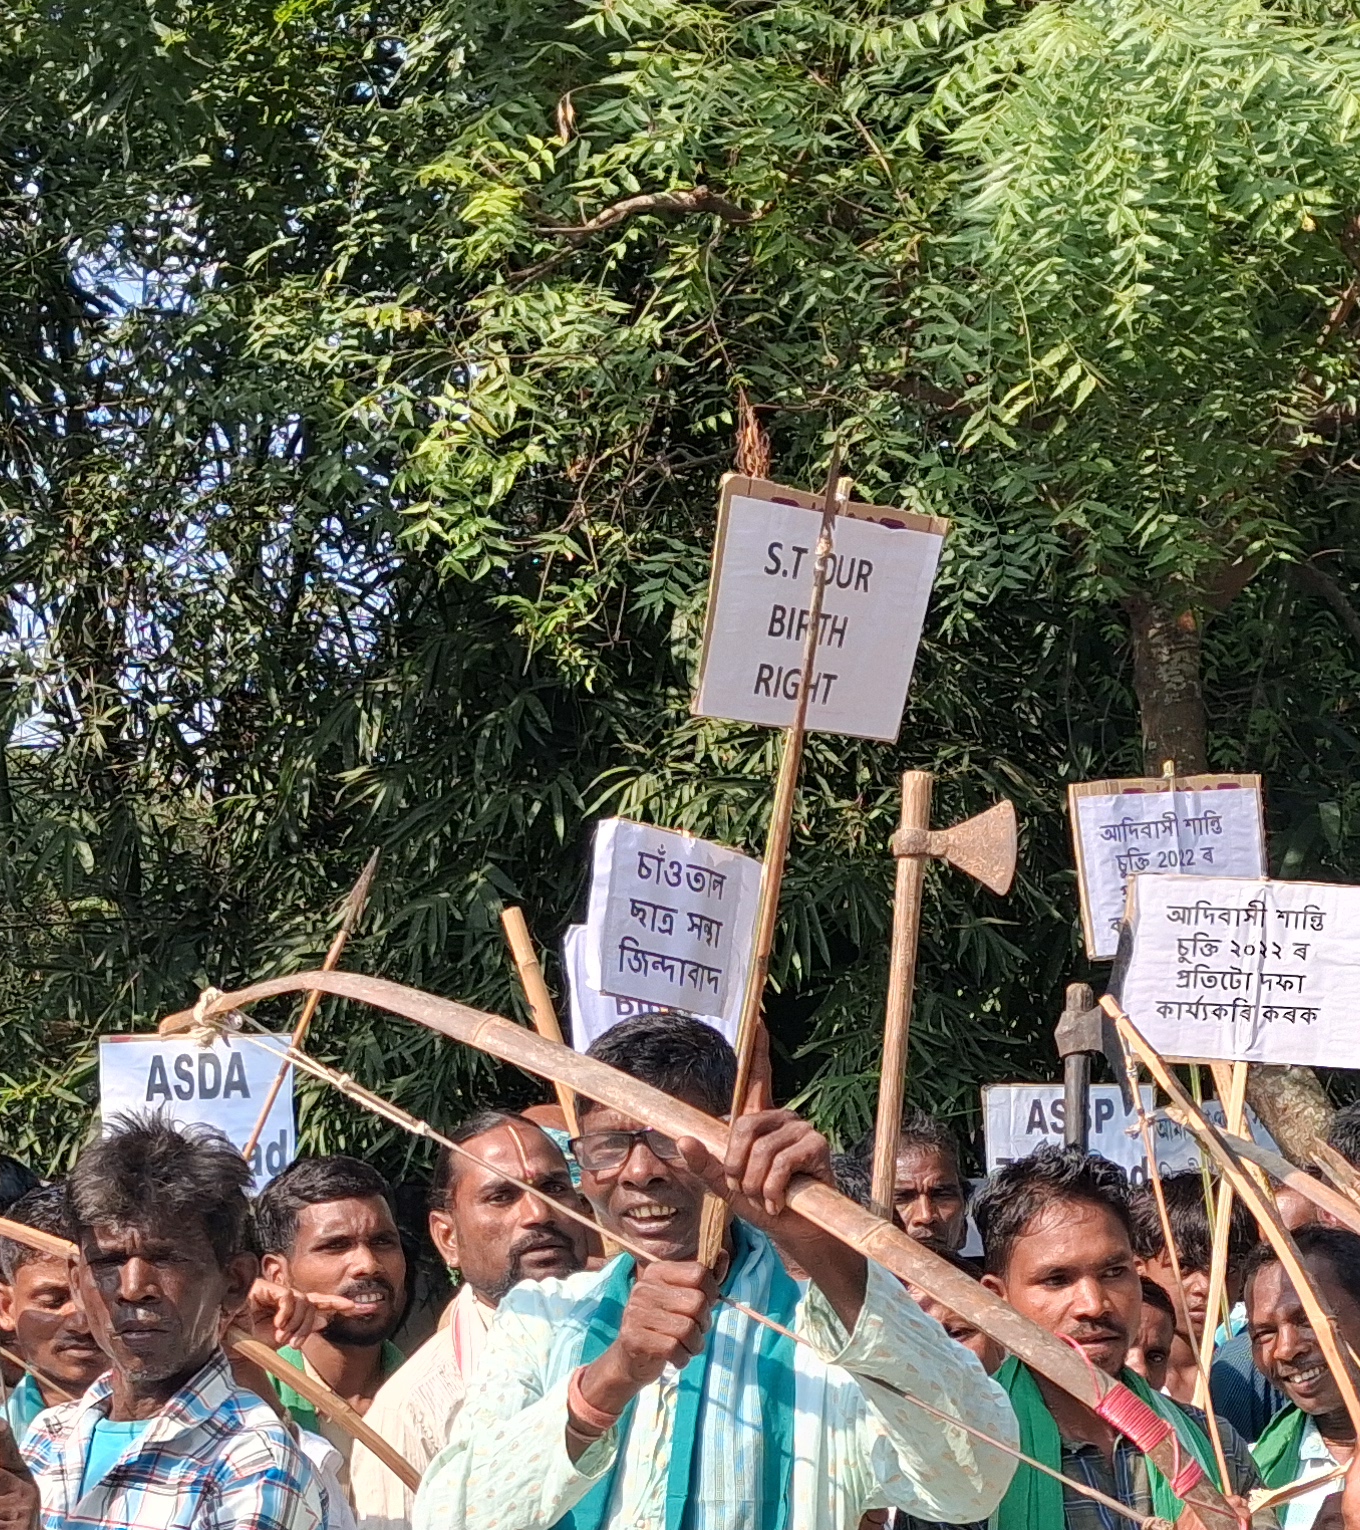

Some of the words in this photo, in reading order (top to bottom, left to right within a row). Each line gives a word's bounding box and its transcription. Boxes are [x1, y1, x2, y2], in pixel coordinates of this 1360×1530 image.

[764, 541, 809, 580] S.T
[768, 604, 849, 649] BIRTH
[753, 662, 839, 706] RIGHT
[1099, 811, 1180, 843] আদিবাসী
[1166, 900, 1268, 929] আদিবাসী
[1276, 905, 1328, 931] শান্তি
[1176, 932, 1223, 964] চুক্তি
[145, 1051, 251, 1102] ASDA
